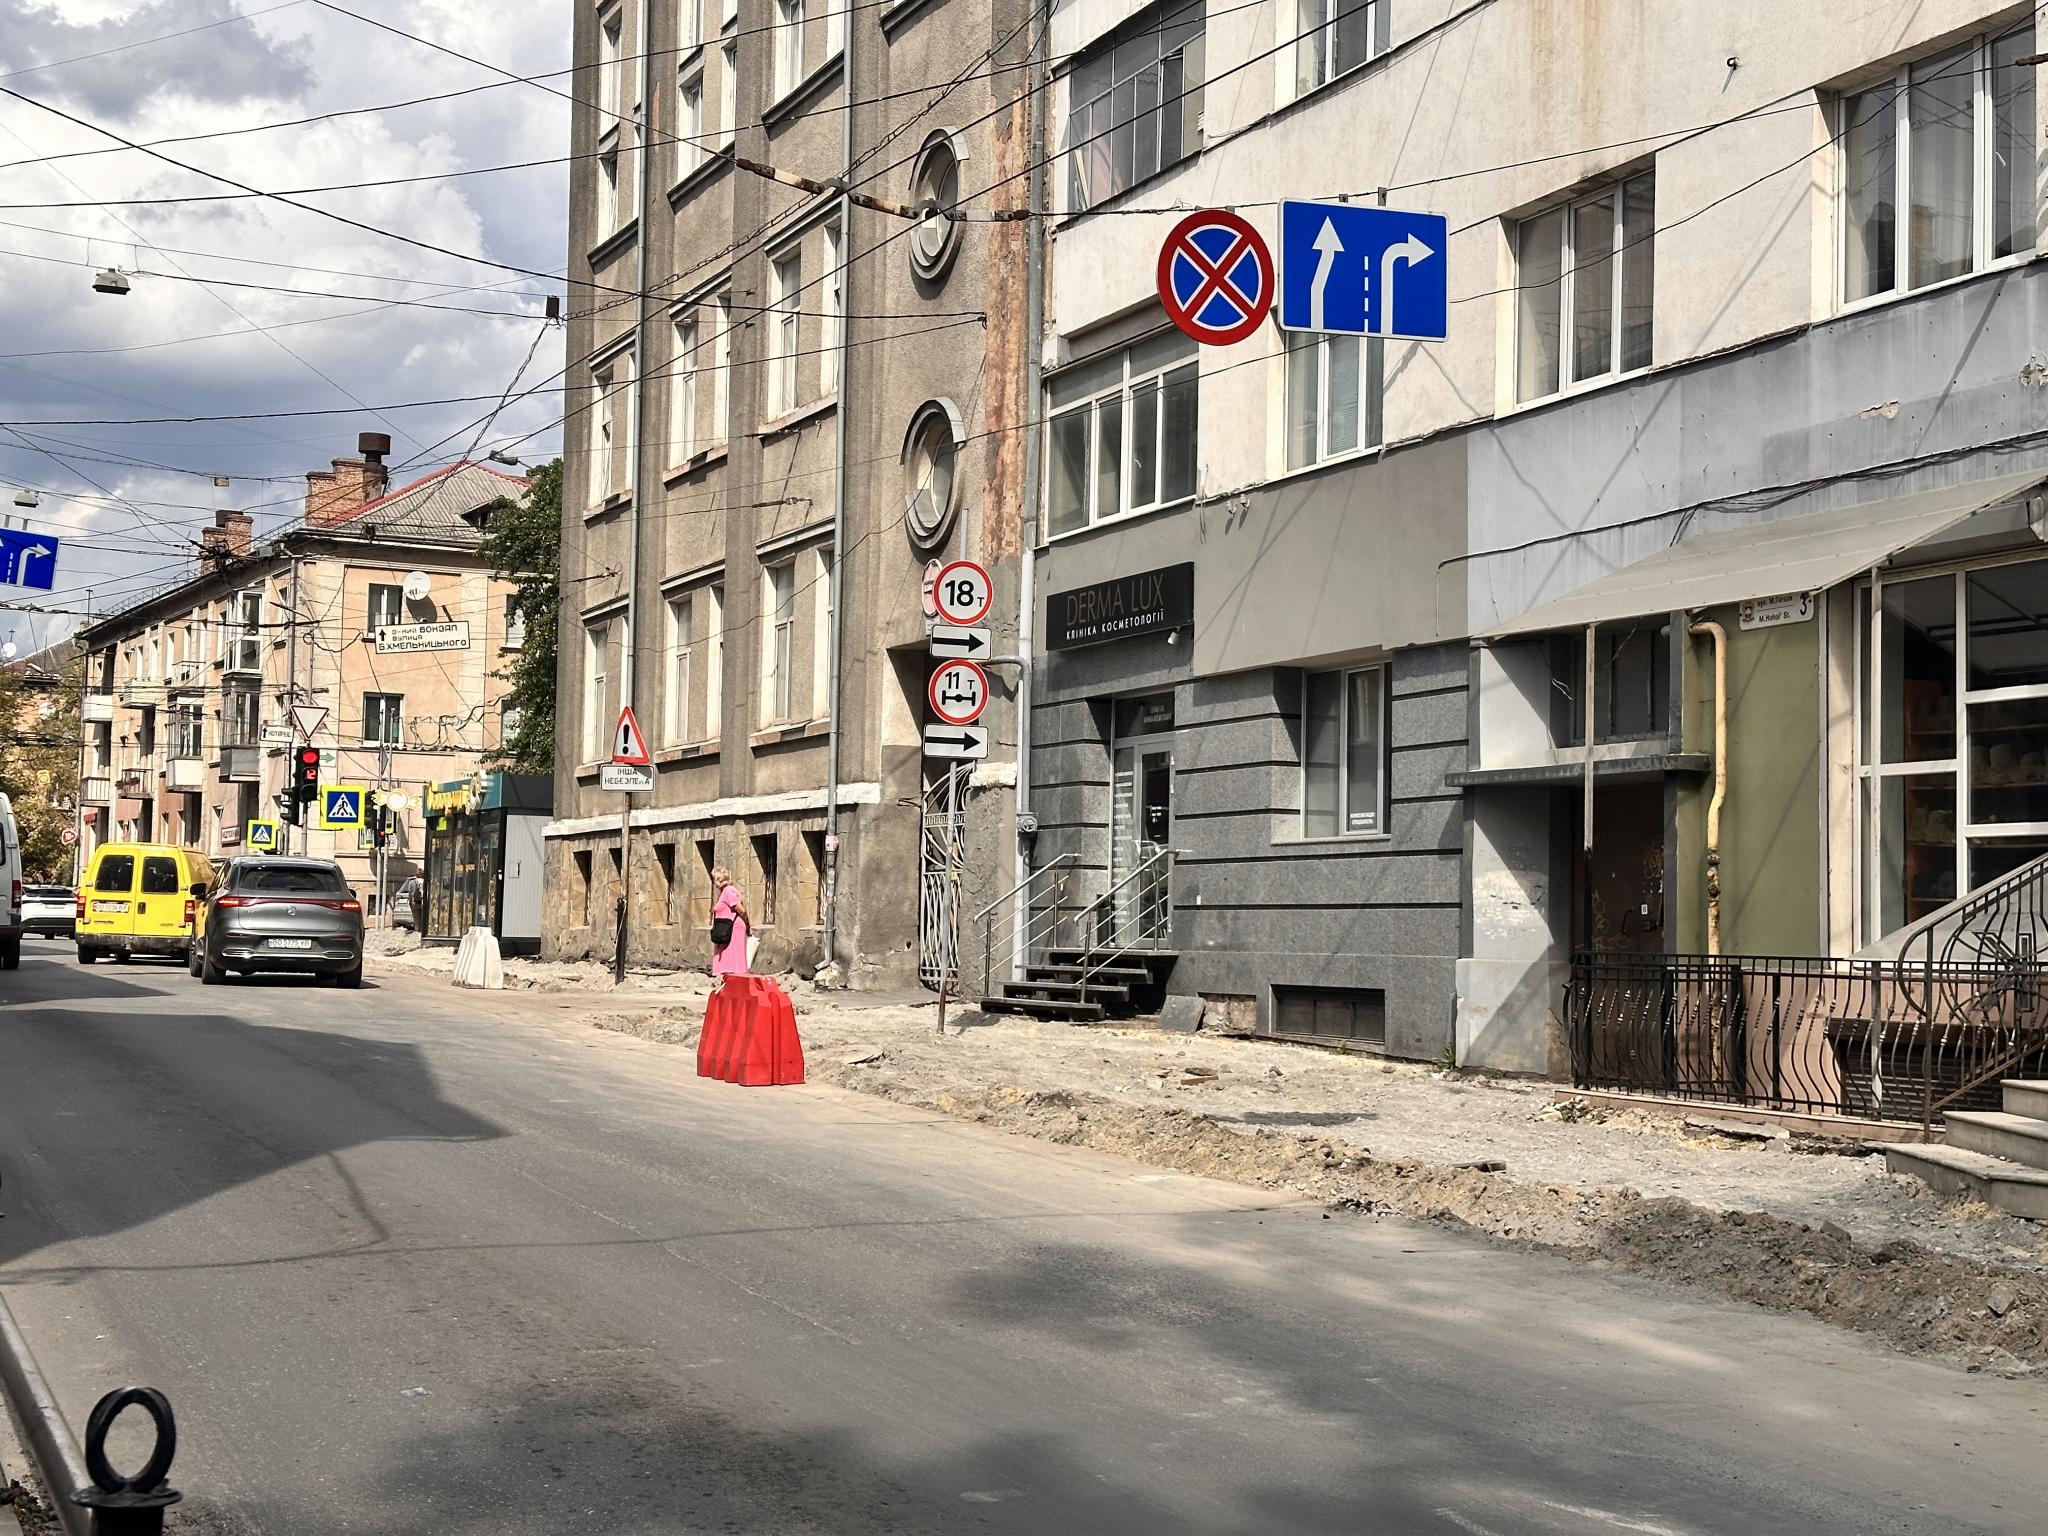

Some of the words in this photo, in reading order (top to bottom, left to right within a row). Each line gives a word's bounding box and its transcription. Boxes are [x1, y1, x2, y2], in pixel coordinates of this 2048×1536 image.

[1066, 583, 1124, 627] DERMA
[1131, 573, 1165, 613] LUX
[1799, 592, 1808, 615] 3
[419, 624, 458, 633] ВОКЗАЛ
[1066, 625, 1098, 641] КЛІНІКА
[1101, 608, 1165, 633] КОСМЕТОЛОГІЇ
[944, 671, 960, 690] 11
[306, 769, 317, 780] 12
[617, 767, 638, 776] ІНША
